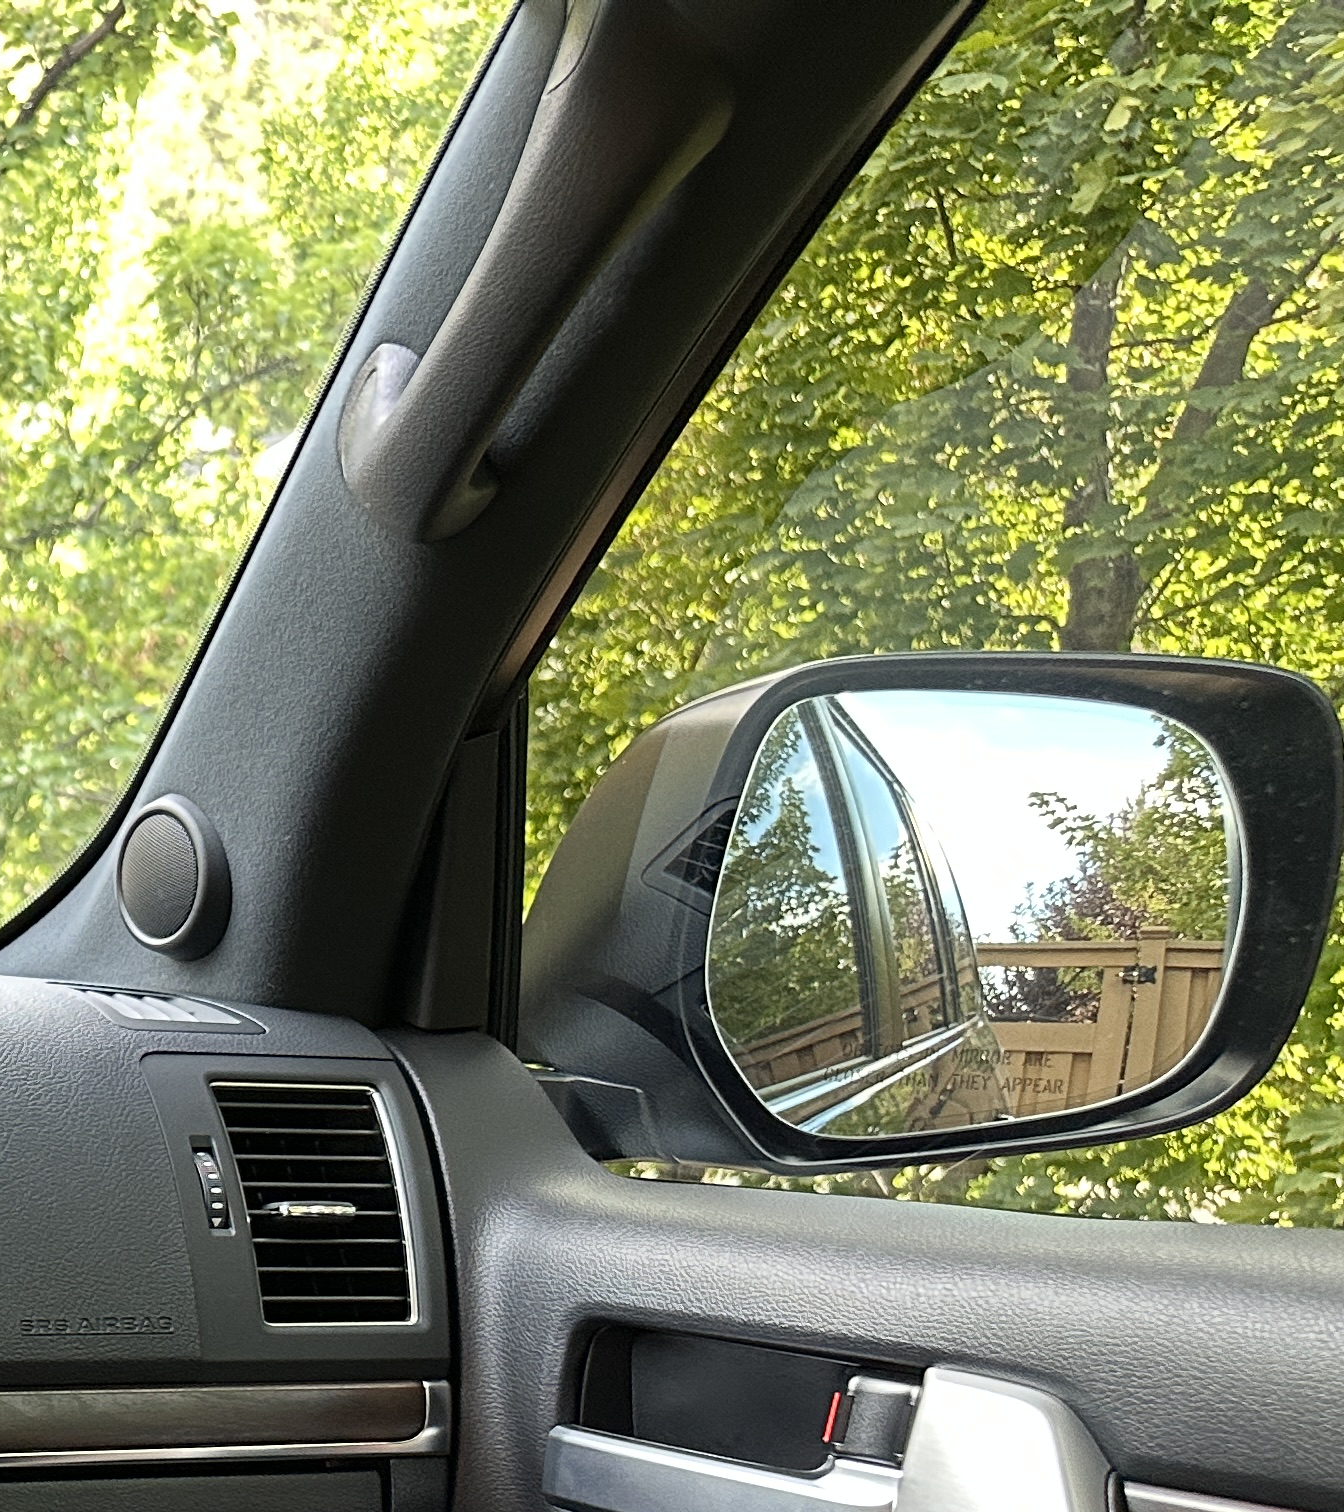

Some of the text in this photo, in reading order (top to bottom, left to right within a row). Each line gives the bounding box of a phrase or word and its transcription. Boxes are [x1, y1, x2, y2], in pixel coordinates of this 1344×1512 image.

[951, 1072, 992, 1091] THEY
[1000, 1076, 1064, 1095] APPEAR
[20, 1318, 70, 1333] SRS
